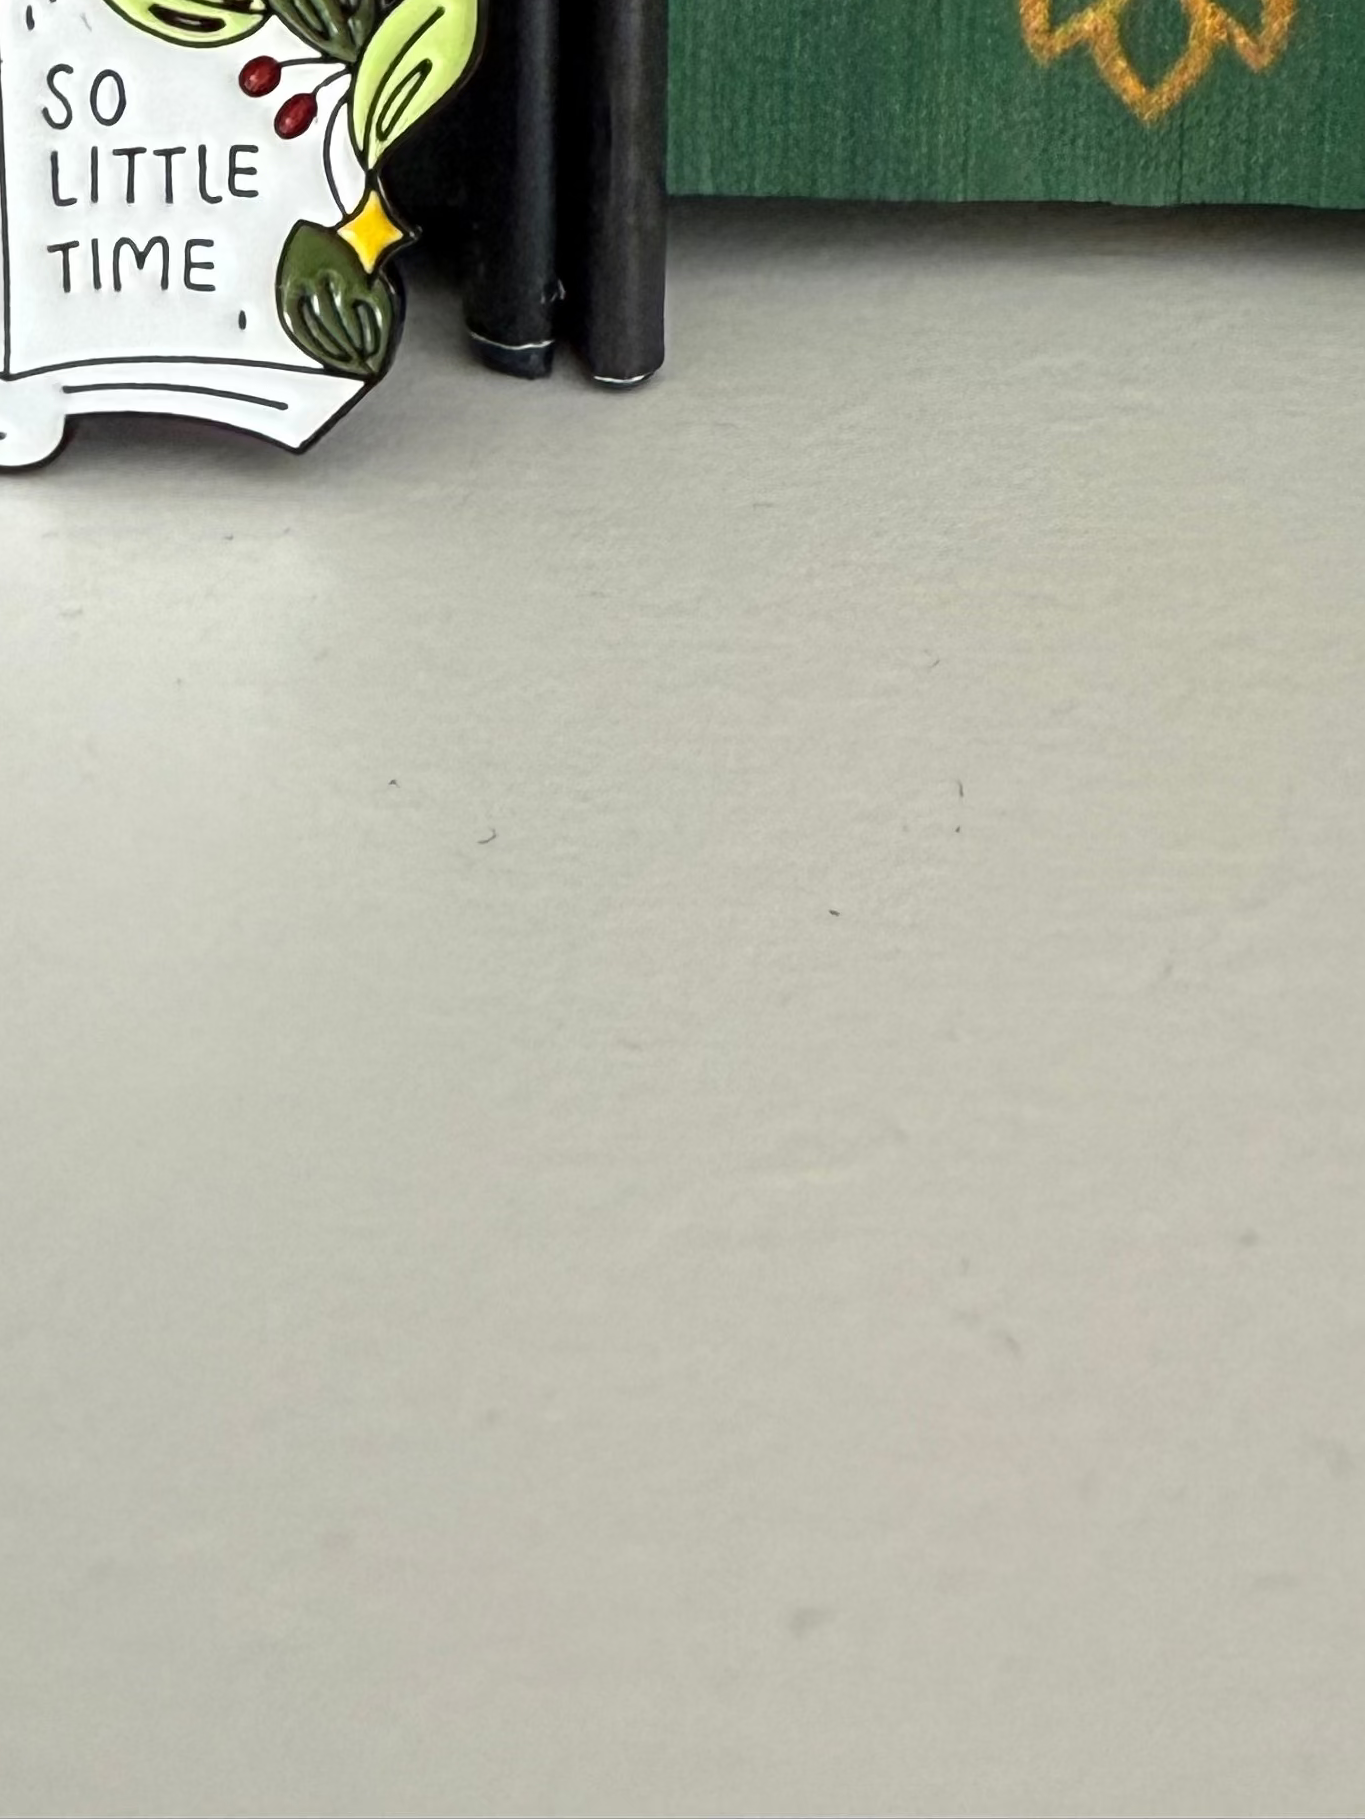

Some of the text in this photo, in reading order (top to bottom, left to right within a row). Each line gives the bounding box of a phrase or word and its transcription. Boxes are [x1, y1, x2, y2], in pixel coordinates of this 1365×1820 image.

[41, 63, 127, 130] SO
[50, 144, 259, 207] LITTLE
[46, 235, 216, 293] TIME
